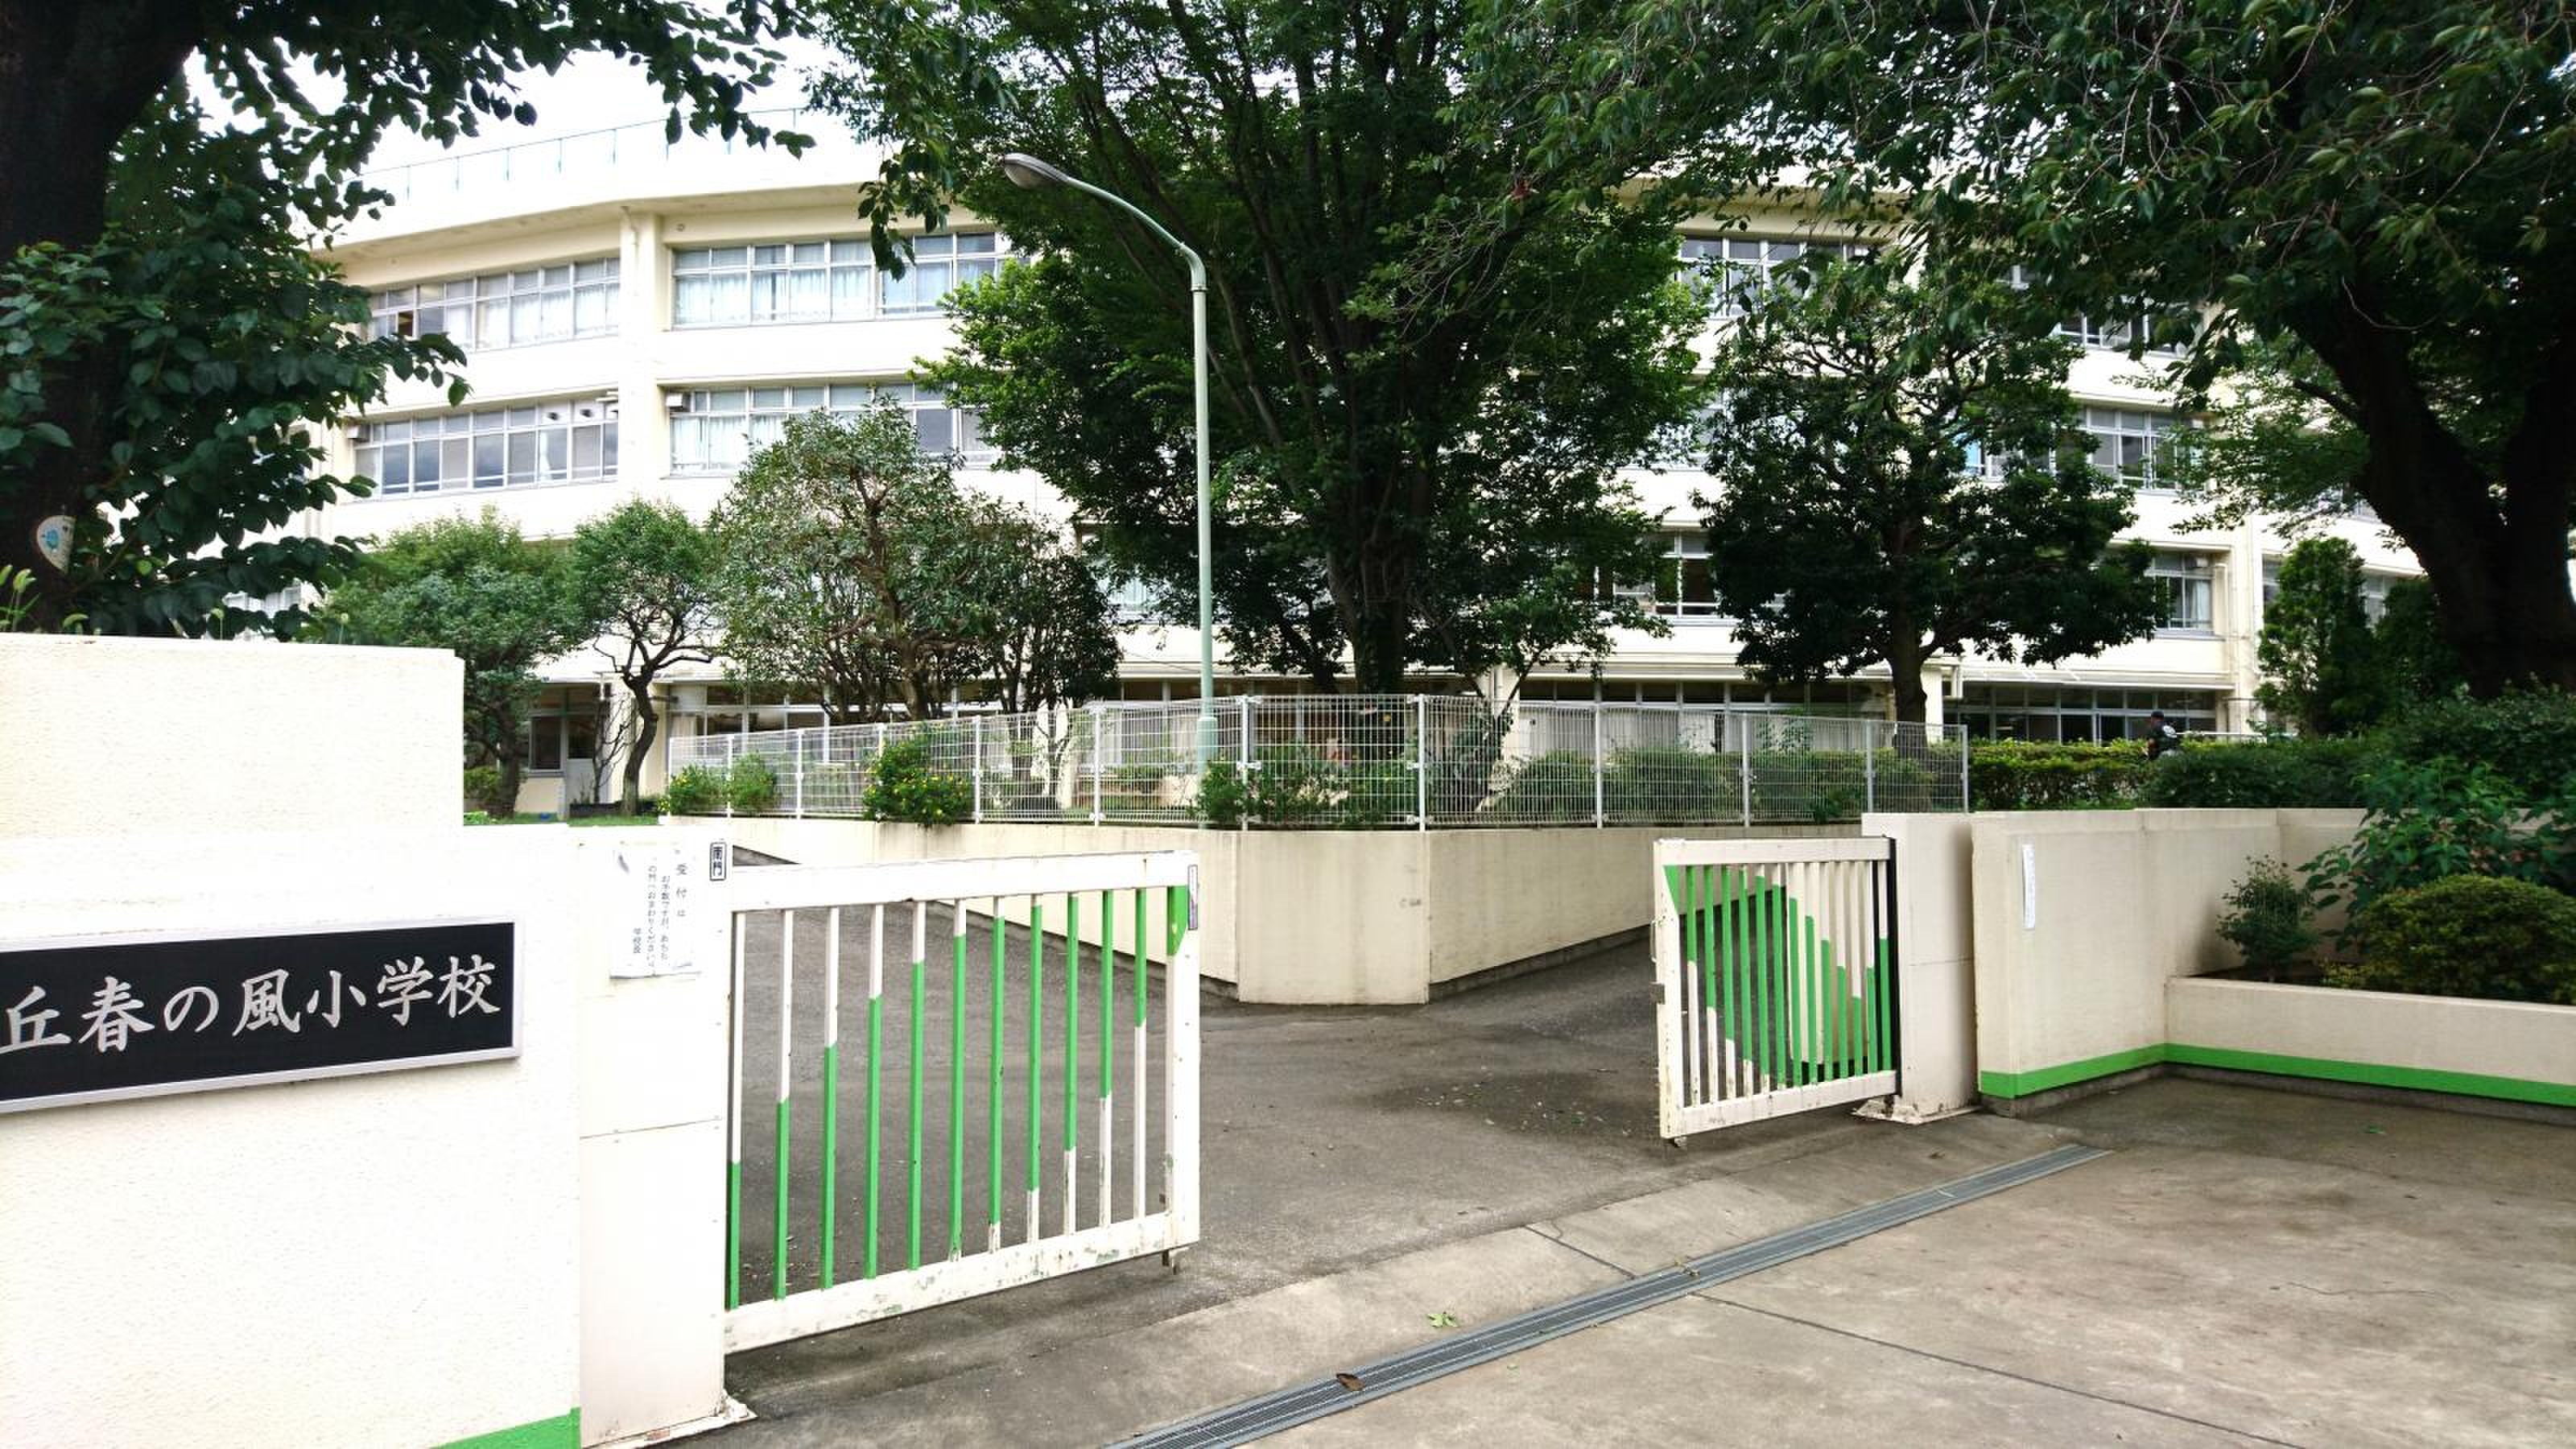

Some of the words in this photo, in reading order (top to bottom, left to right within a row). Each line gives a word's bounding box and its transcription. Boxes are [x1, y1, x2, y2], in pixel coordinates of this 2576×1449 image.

[0, 955, 502, 1053] 丘春の風小学校
